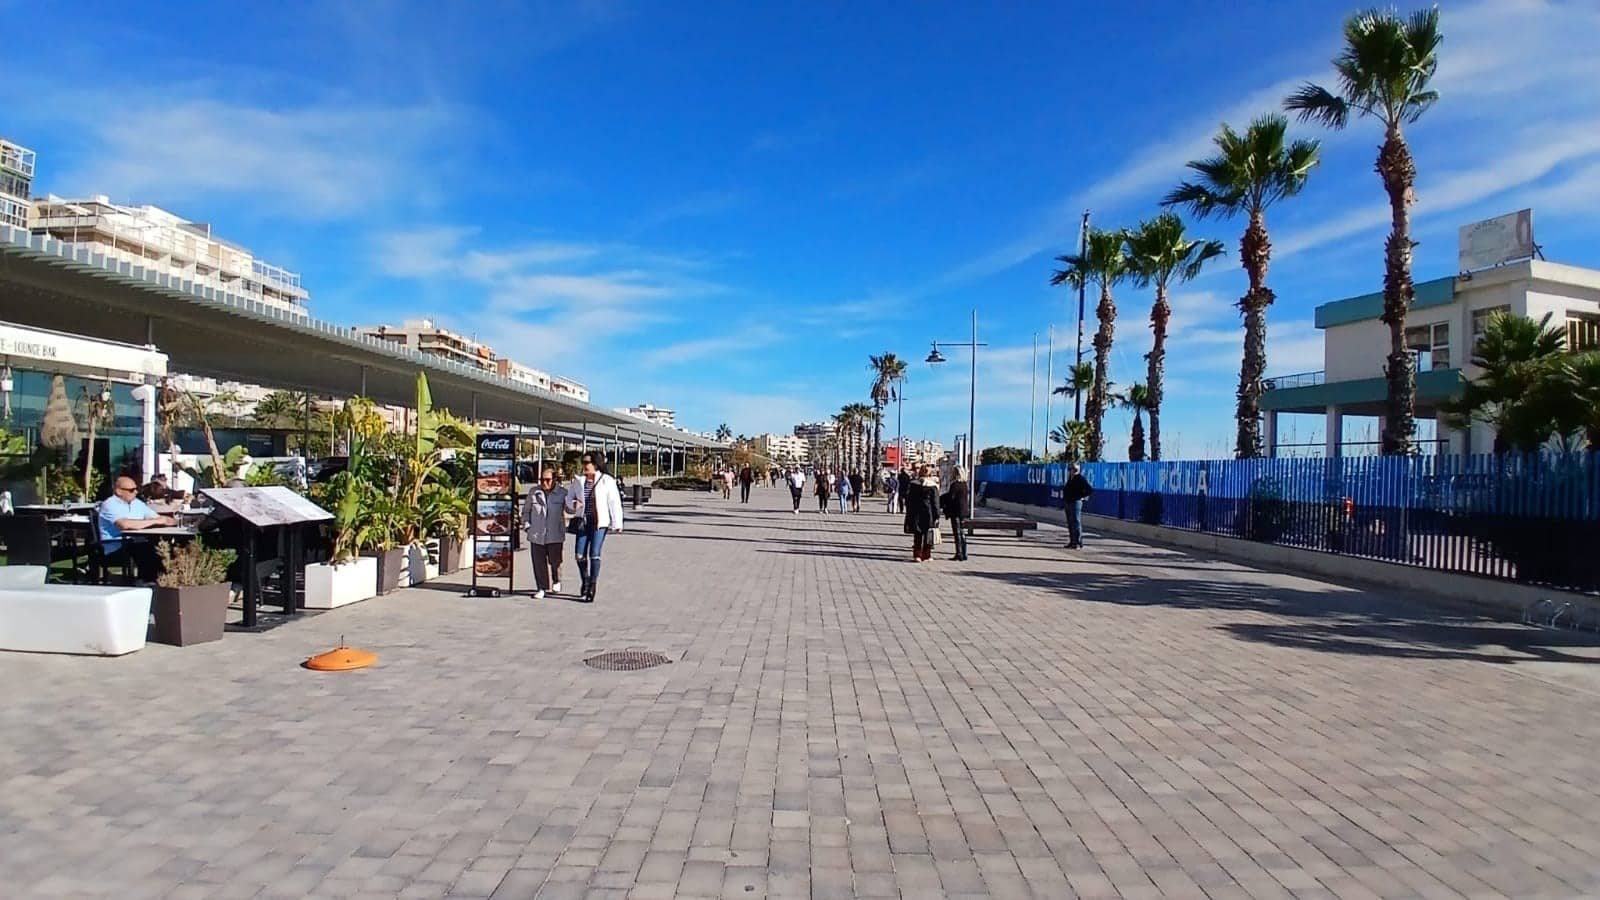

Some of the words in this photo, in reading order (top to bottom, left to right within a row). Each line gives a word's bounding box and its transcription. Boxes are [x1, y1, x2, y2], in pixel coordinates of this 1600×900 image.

[14, 340, 41, 356] LOUNGE
[42, 344, 57, 358] BAR
[1027, 467, 1047, 484] CLUB
[1103, 467, 1147, 492] SANTA
[1160, 469, 1208, 497] POLA
